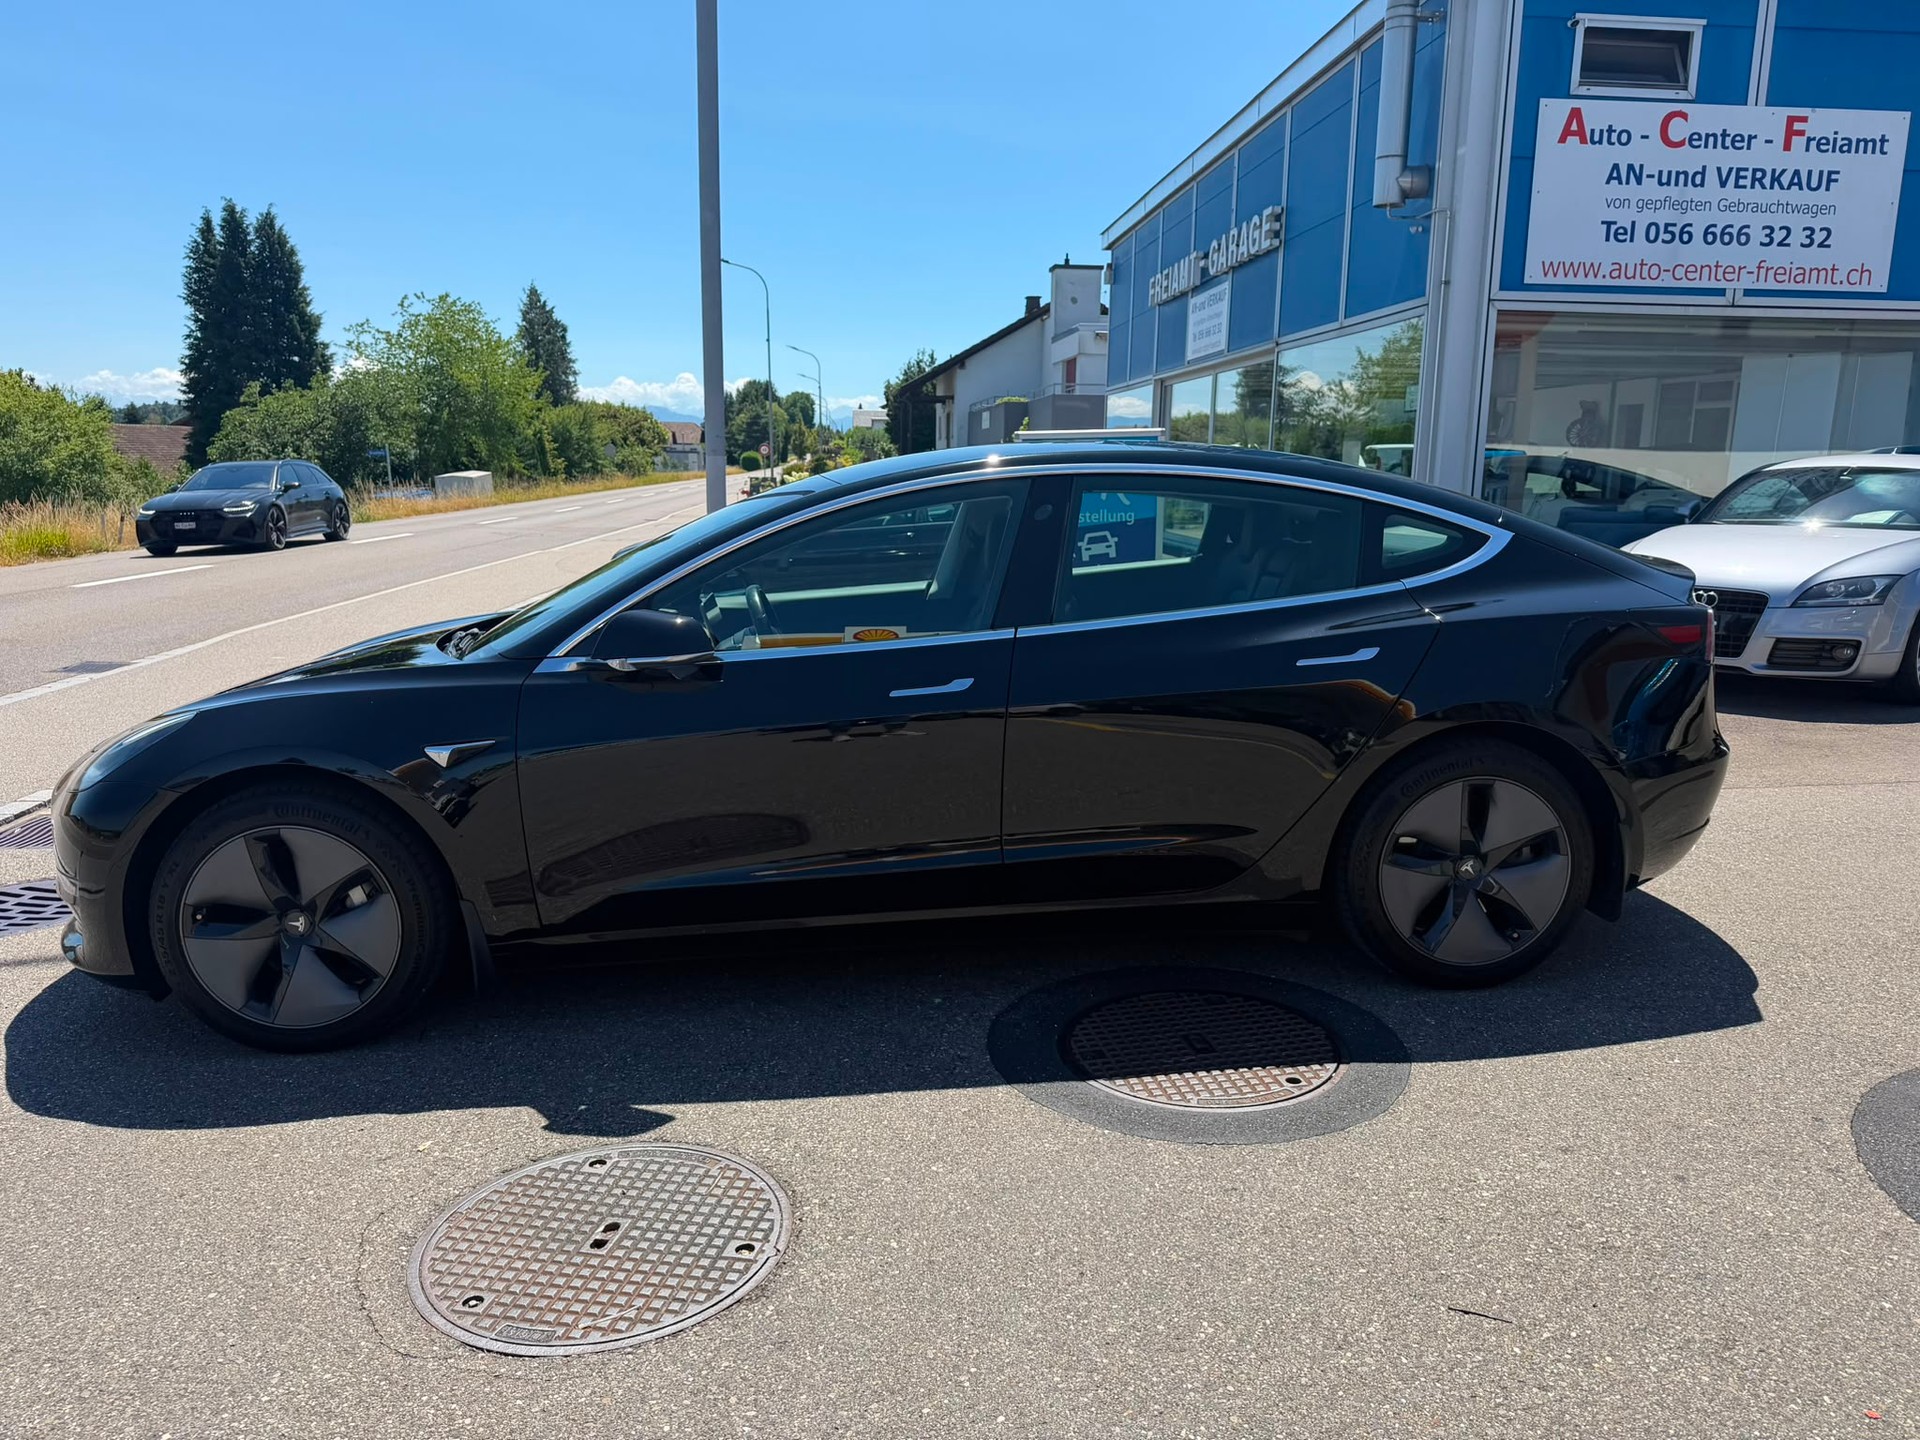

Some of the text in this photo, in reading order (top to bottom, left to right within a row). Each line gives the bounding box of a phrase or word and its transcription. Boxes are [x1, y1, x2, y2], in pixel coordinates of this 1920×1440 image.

[1557, 107, 1632, 147] Auto
[1660, 110, 1757, 151] Center
[1783, 115, 1889, 155] Freiamt
[1605, 163, 1840, 192] AN-und VERKAUF
[1605, 196, 1837, 218] von gepflegten Gebrauchtwagen
[1601, 220, 1832, 248] Tel 056 666 32 32
[1541, 259, 1872, 287] www.auto-center-freiamt.ch
